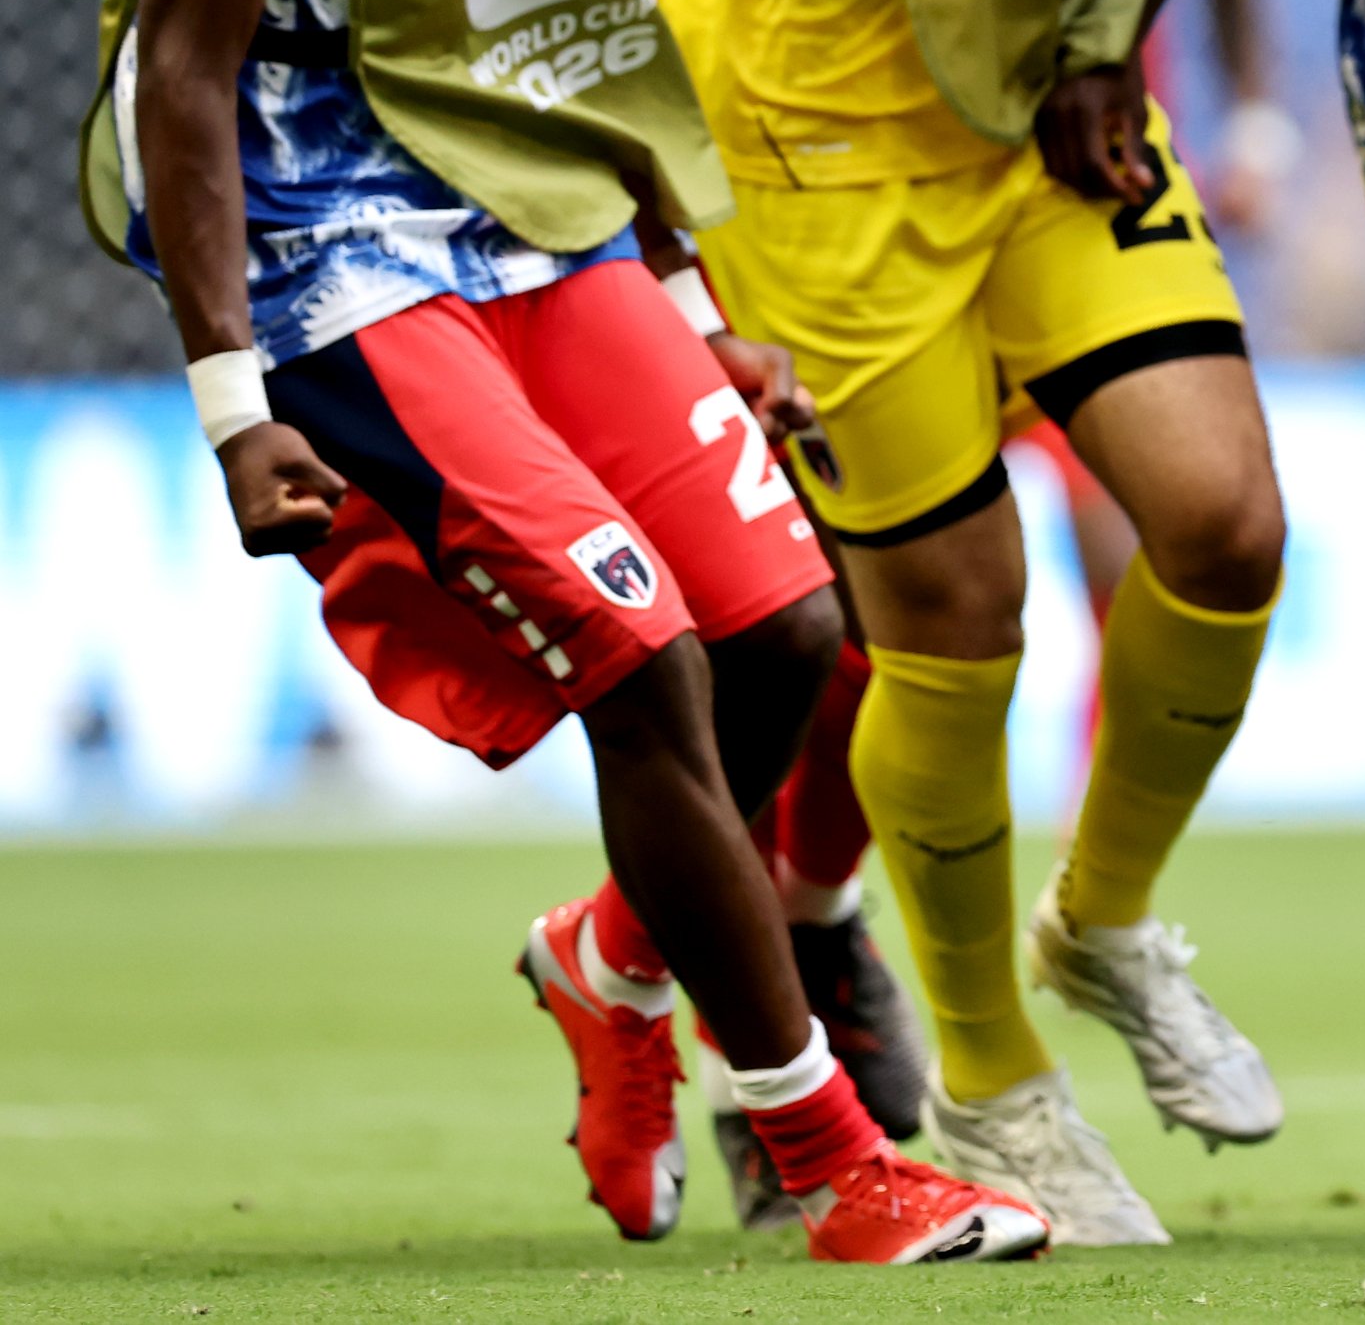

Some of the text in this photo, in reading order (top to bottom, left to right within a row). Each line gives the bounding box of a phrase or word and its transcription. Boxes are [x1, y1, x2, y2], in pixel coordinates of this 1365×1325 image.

[470, 12, 577, 87] WORLD
[505, 23, 659, 113] 026
[1108, 141, 1216, 253] 2
[688, 383, 797, 524] 2
